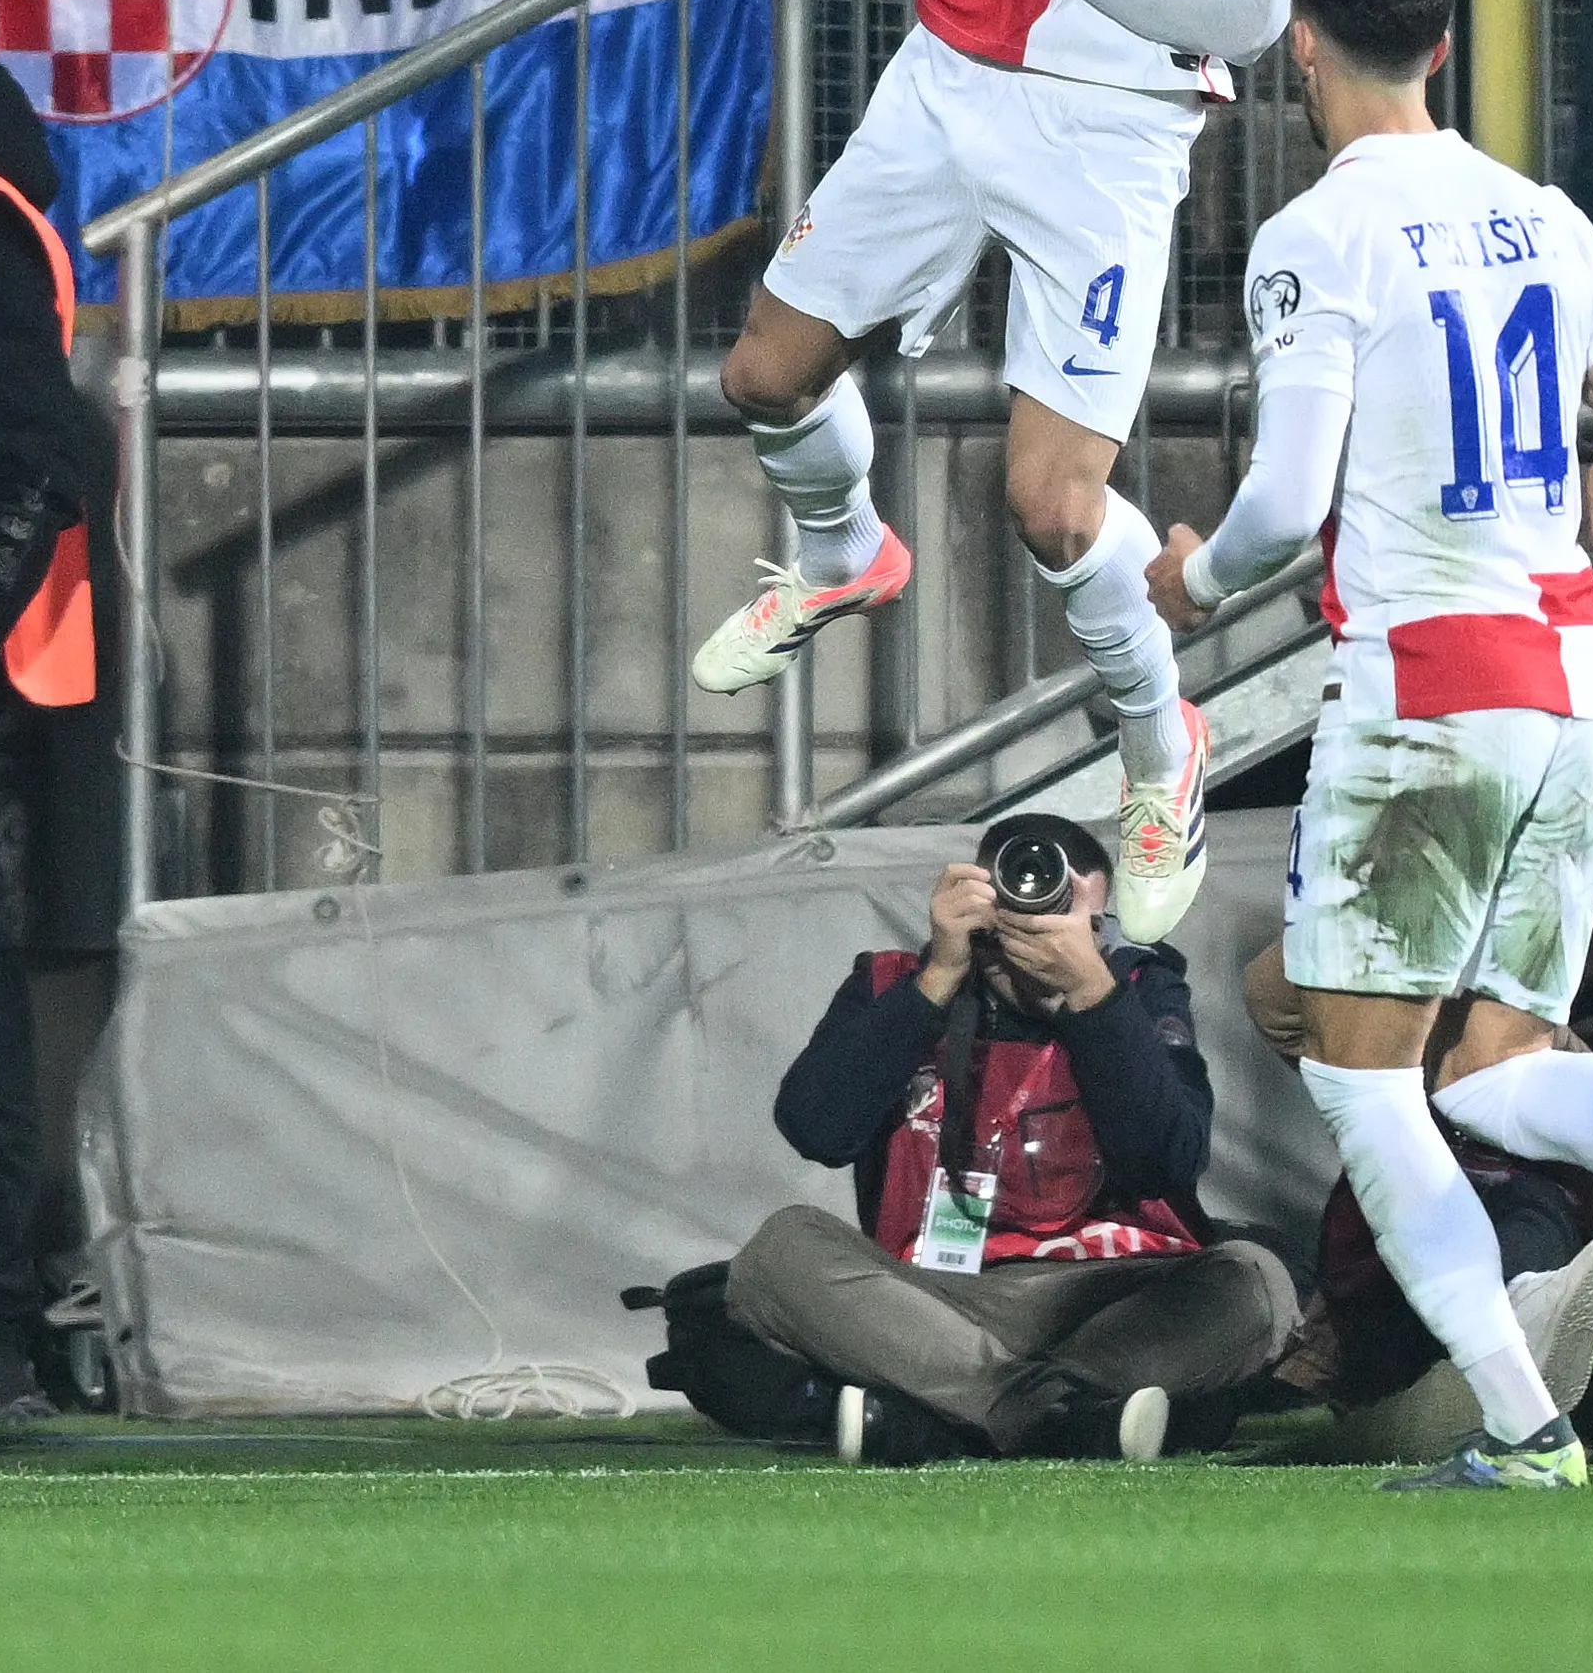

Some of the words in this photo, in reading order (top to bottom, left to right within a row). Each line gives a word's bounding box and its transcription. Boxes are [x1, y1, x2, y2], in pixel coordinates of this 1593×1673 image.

[1401, 207, 1550, 269] PIŠI
[1080, 263, 1128, 350] 4
[1427, 283, 1569, 523] 14
